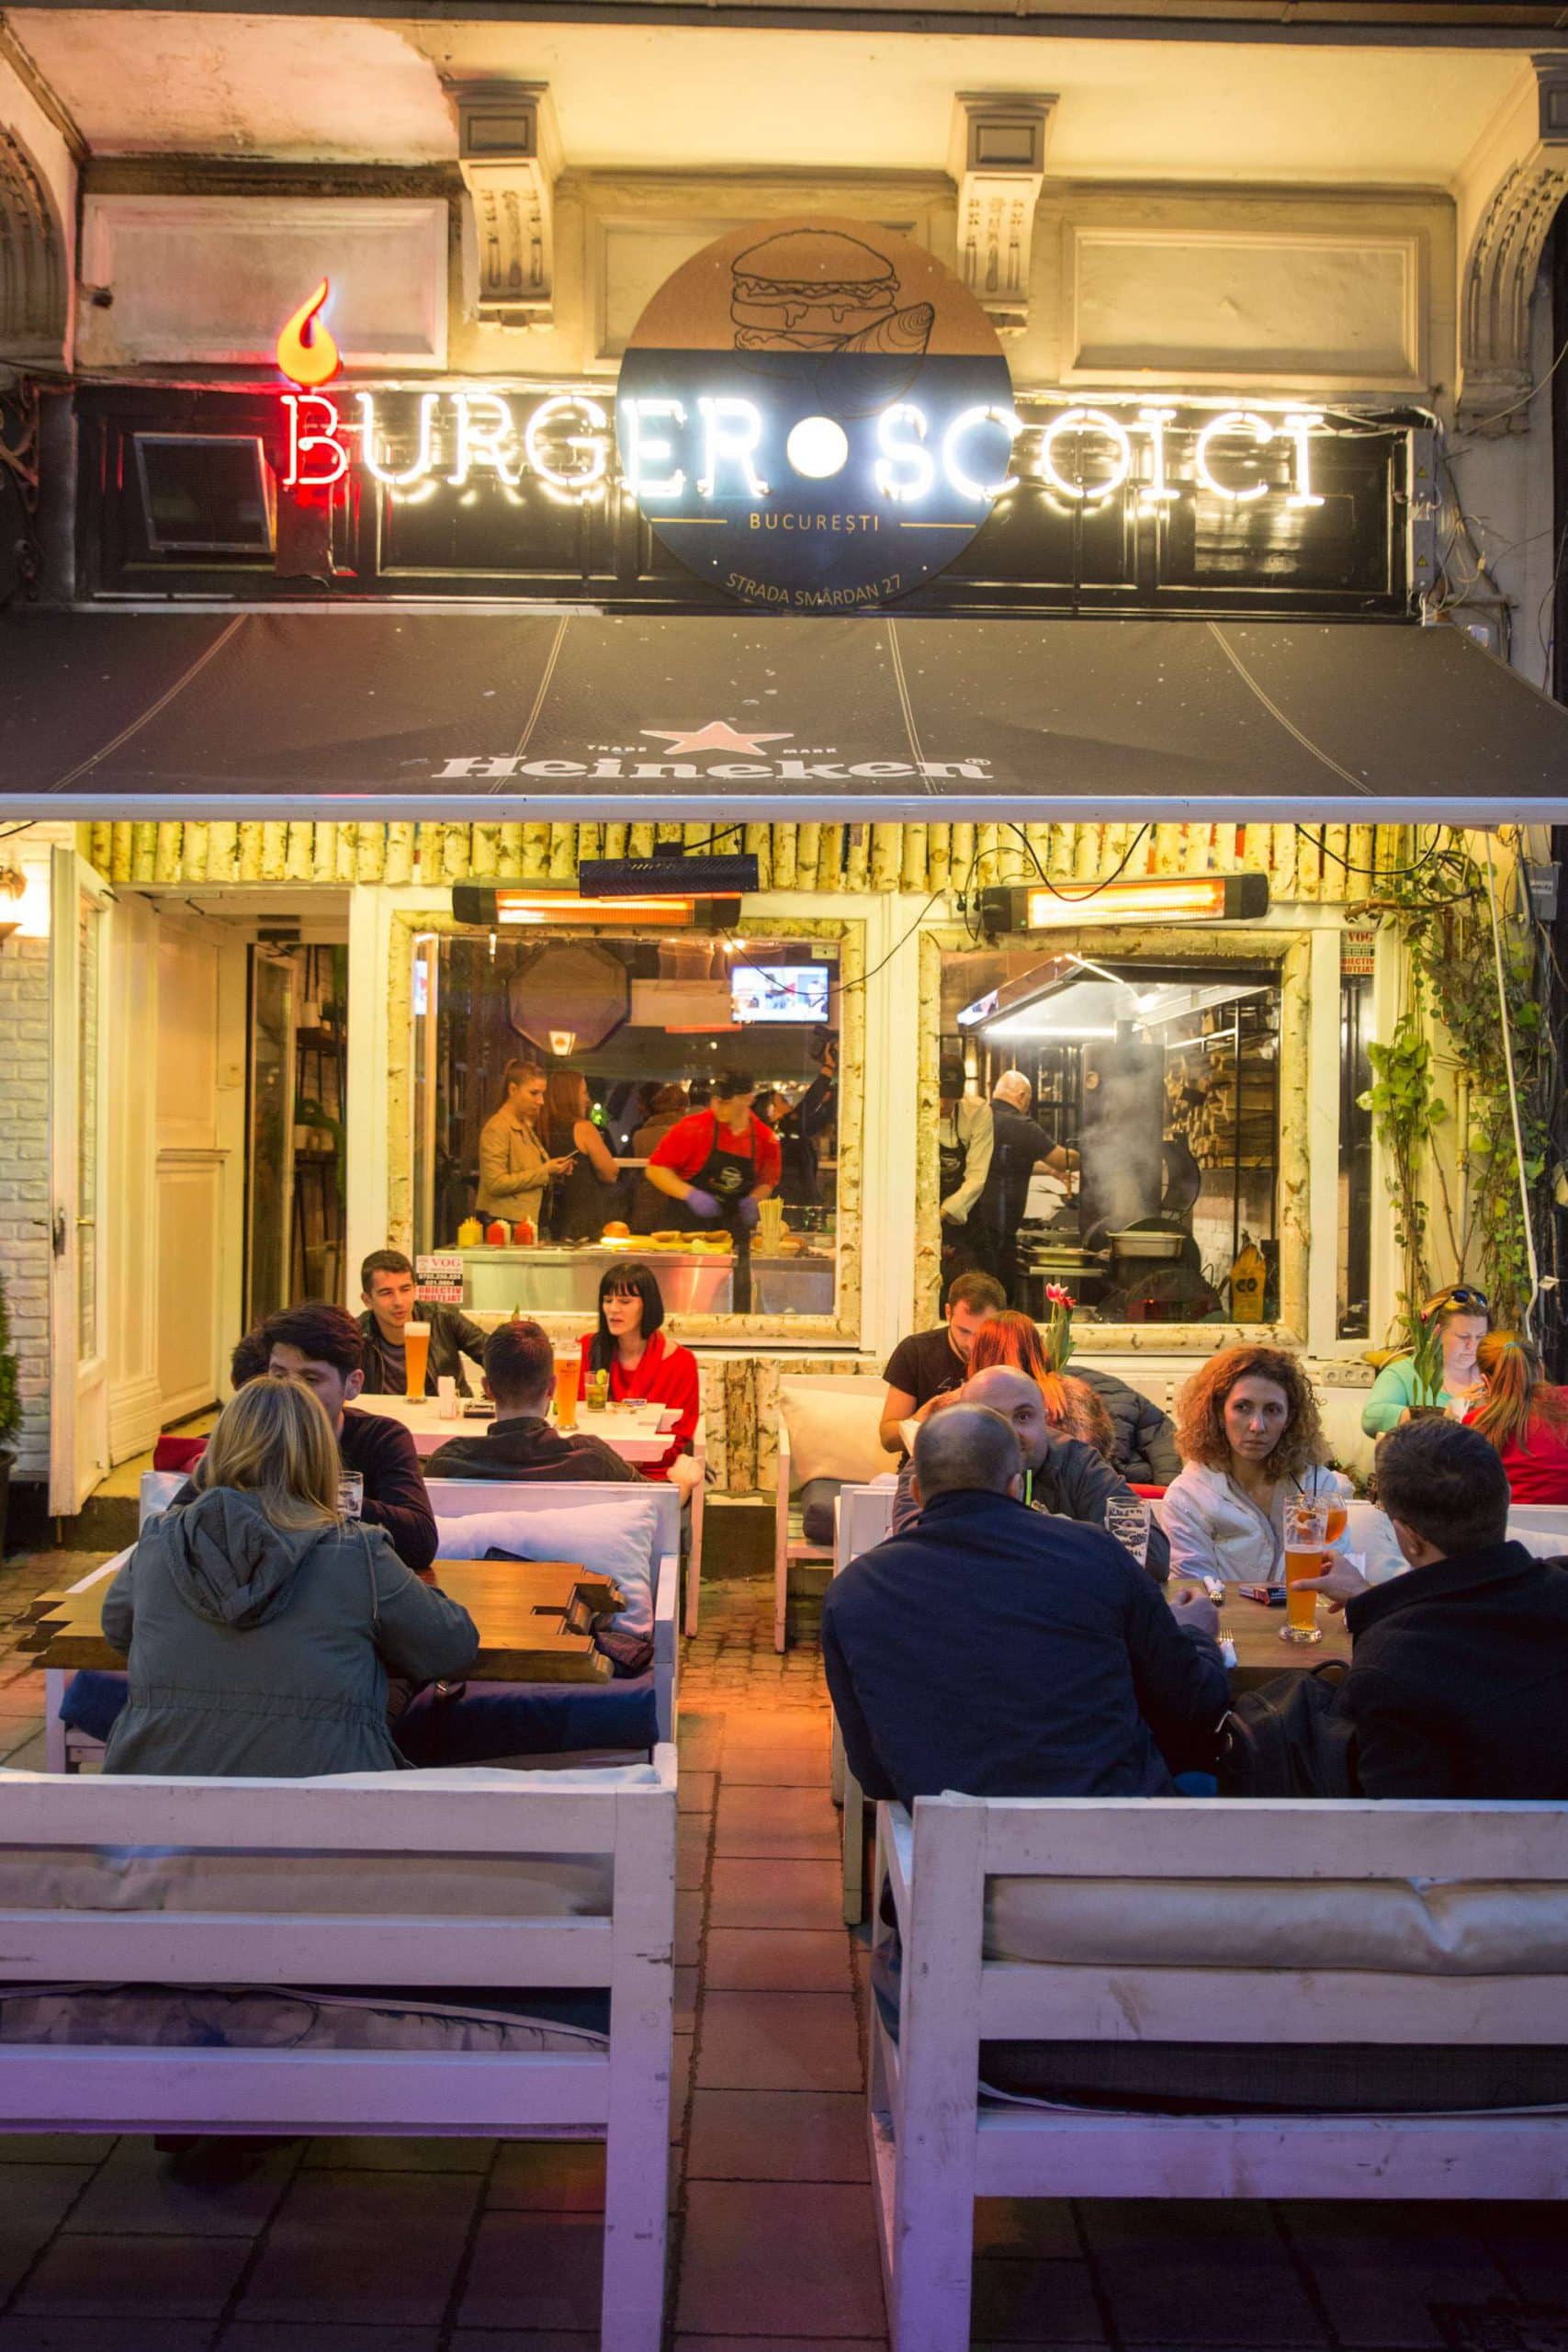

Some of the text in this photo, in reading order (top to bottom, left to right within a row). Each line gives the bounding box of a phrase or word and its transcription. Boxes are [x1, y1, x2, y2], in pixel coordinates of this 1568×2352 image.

[280, 393, 1326, 507] BURGER SCOICI
[727, 571, 790, 604] STRADA
[881, 572, 902, 594] 27
[587, 744, 647, 752] TRADE
[431, 755, 995, 780] Heineken
[1348, 932, 1373, 942] VOG
[432, 1258, 461, 1267] VOG
